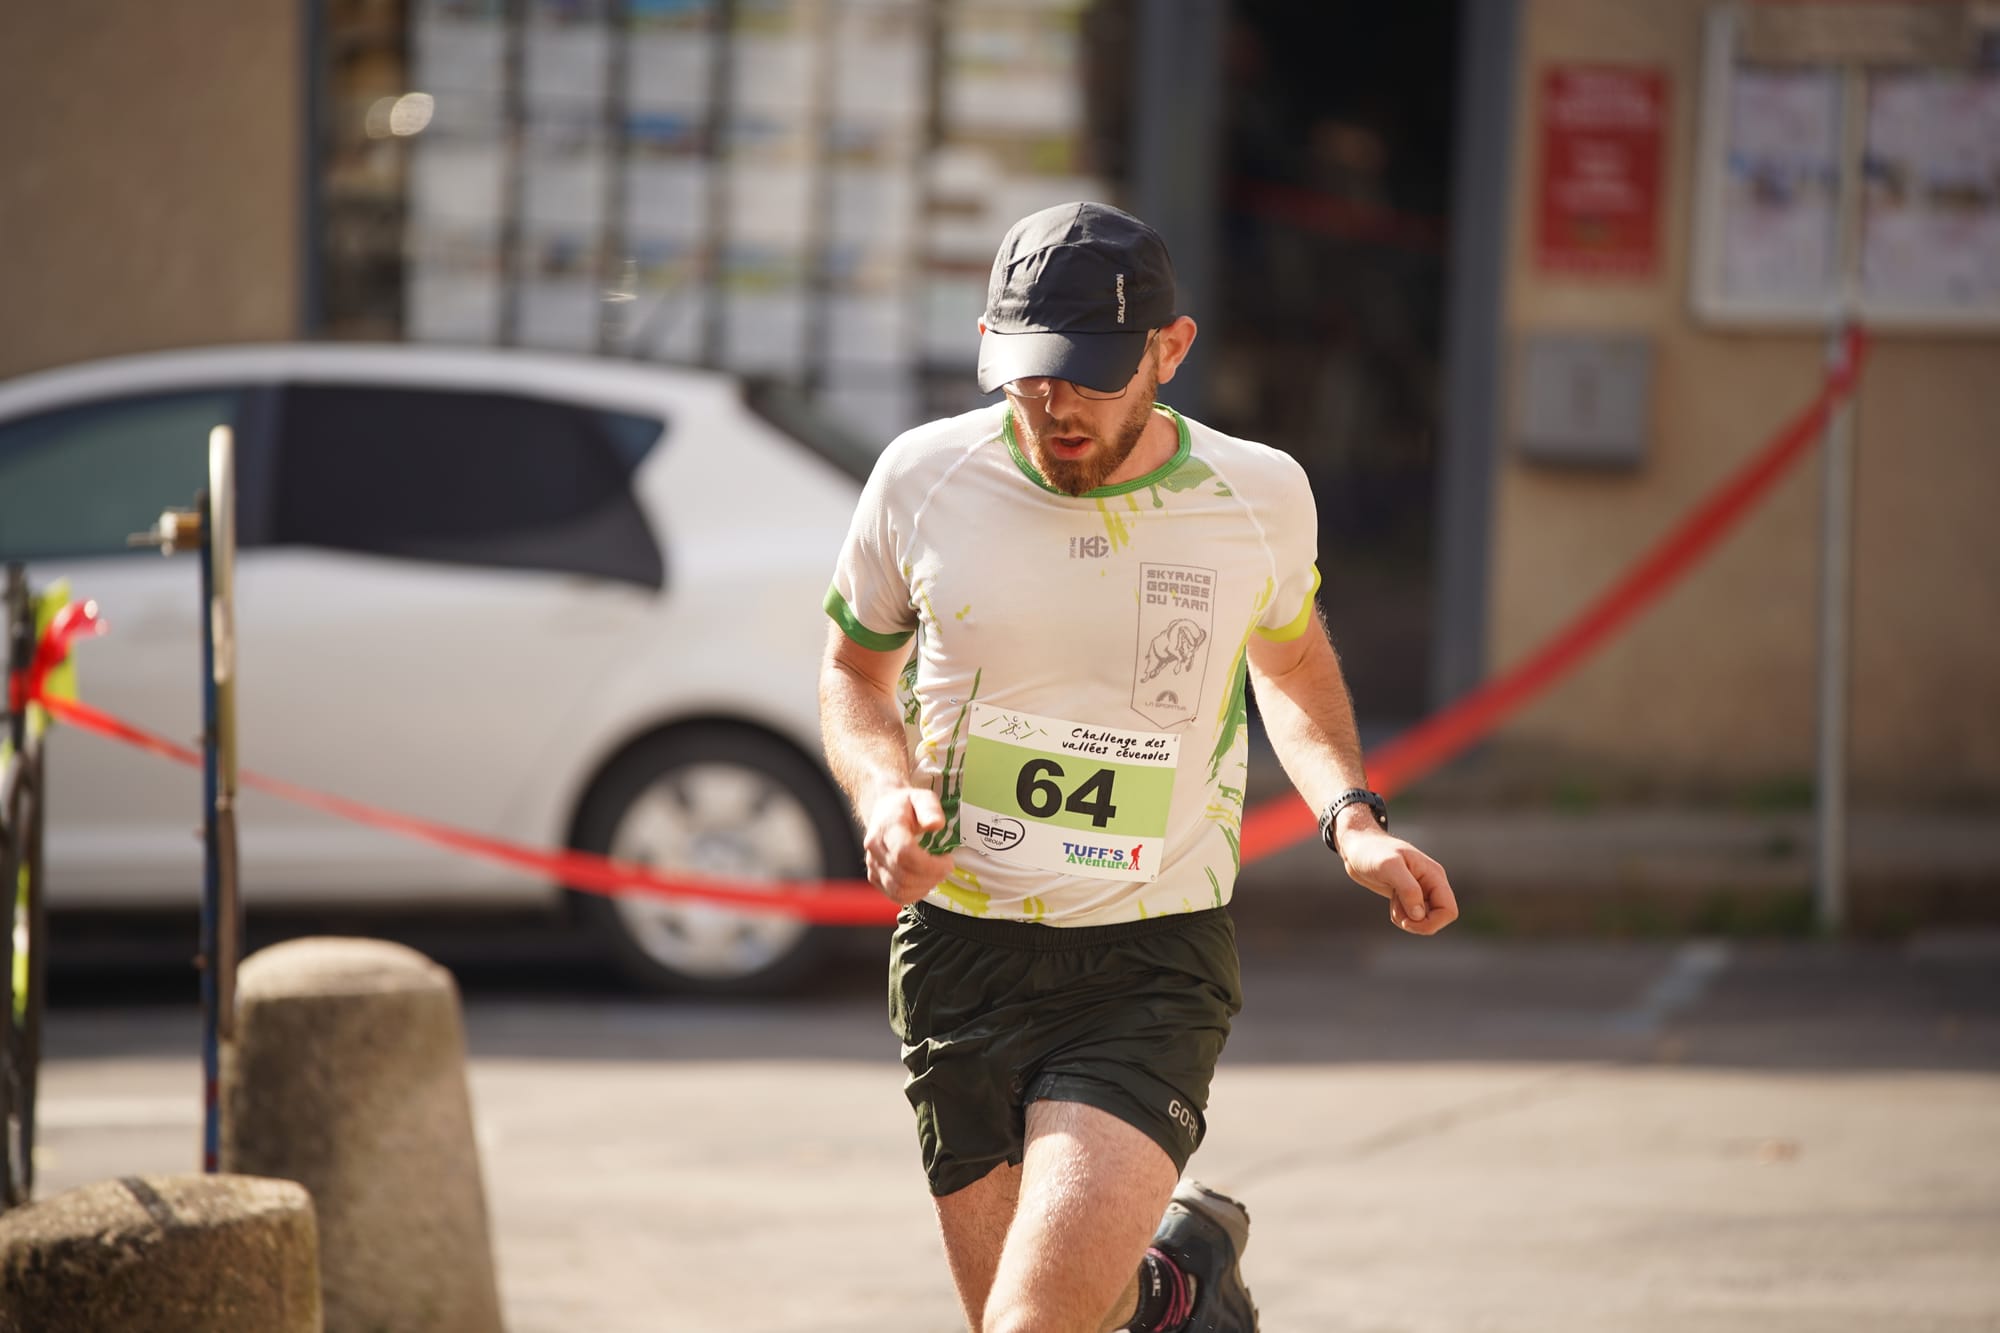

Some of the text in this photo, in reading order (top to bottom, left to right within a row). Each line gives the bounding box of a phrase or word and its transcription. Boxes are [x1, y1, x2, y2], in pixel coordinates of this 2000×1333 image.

[1116, 273, 1126, 324] SALOMON
[1146, 569, 1211, 585] SKYRACE
[1146, 580, 1210, 599] GORGES
[1146, 593, 1167, 605] DU
[1071, 728, 1166, 749] Challenge des
[1062, 741, 1170, 761] vallées cévenoles
[1016, 758, 1117, 828] 64
[976, 821, 1017, 842] BFP
[1062, 842, 1124, 861] TUFF'S
[1066, 851, 1129, 870] Aventure
